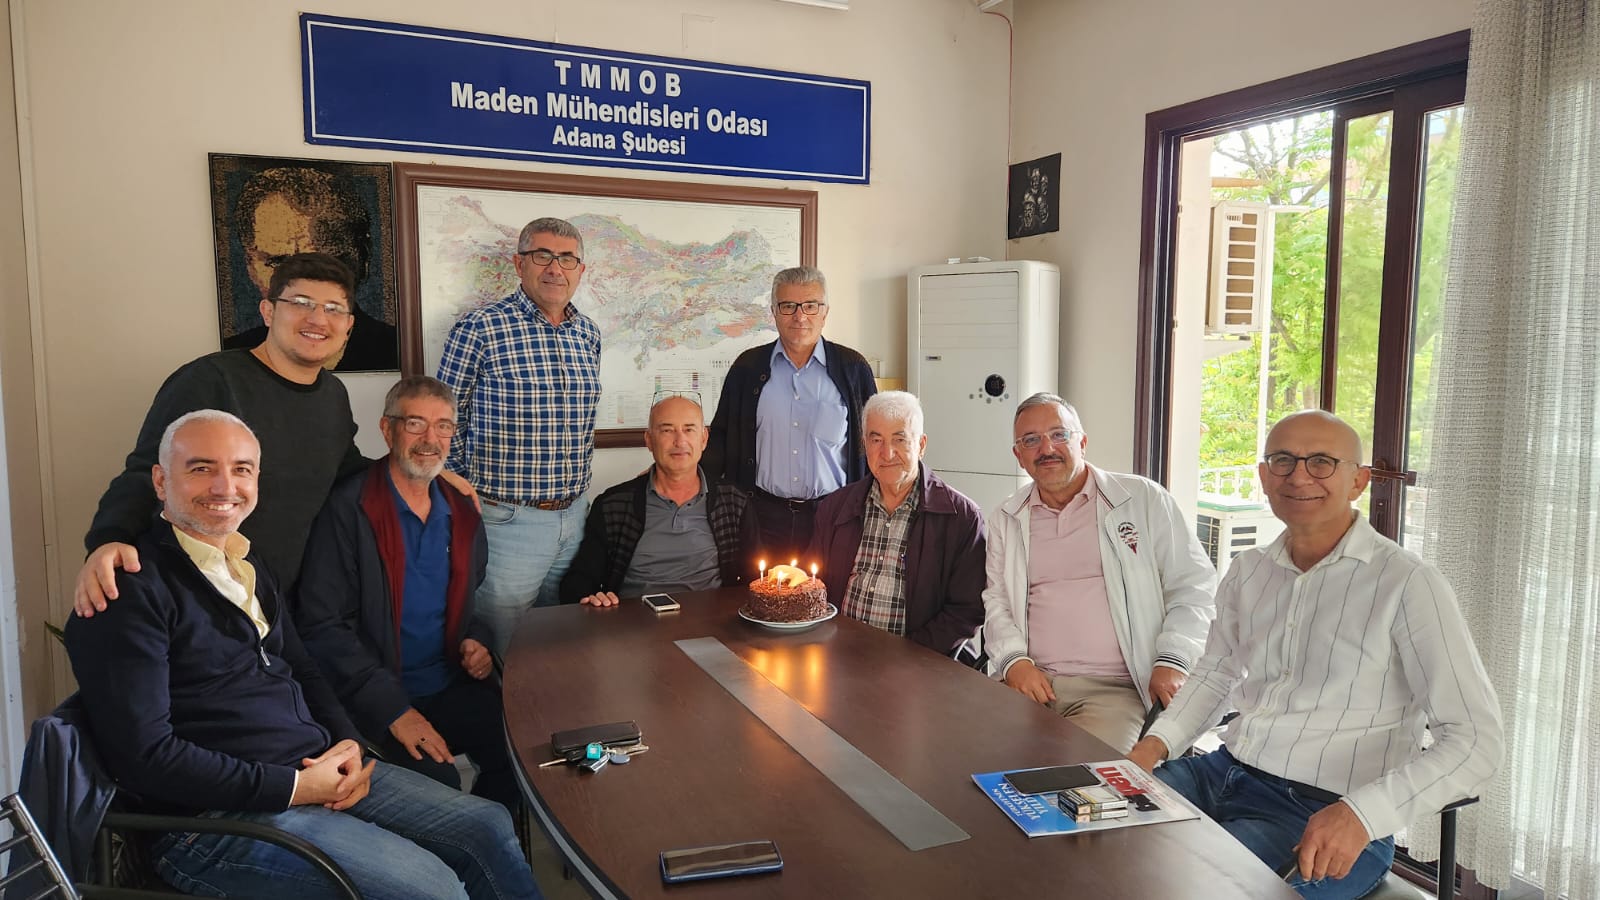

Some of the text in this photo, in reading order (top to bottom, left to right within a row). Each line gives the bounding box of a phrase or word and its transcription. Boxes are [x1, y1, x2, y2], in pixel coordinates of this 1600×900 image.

[450, 81, 768, 137] Maden Mühendisleri Odası
[552, 124, 686, 156] Adana Şubesi
